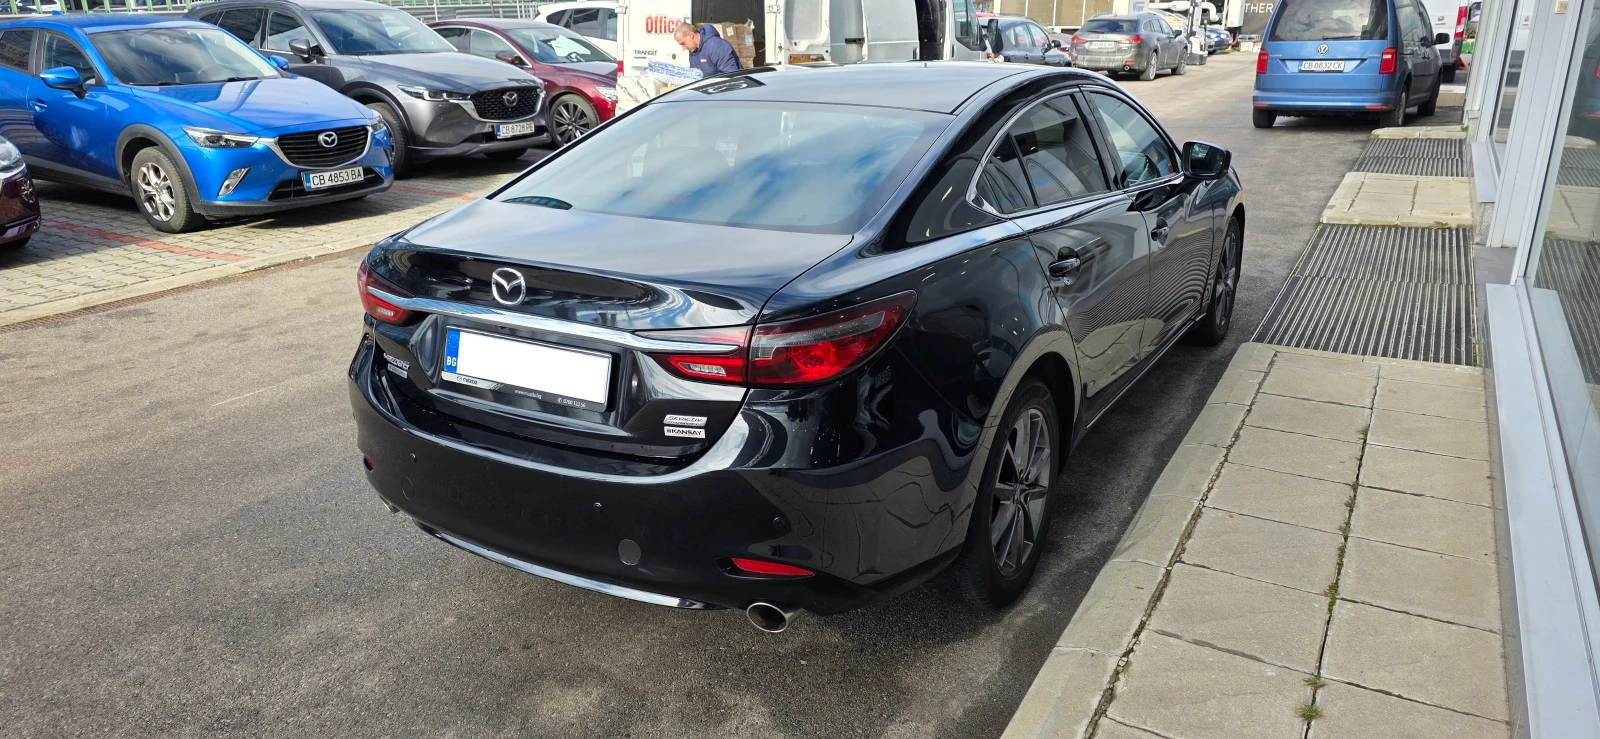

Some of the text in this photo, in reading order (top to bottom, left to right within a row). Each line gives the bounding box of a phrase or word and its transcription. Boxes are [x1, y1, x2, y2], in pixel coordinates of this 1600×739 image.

[311, 168, 363, 186] CB 4853 BA
[446, 355, 457, 367] BG
